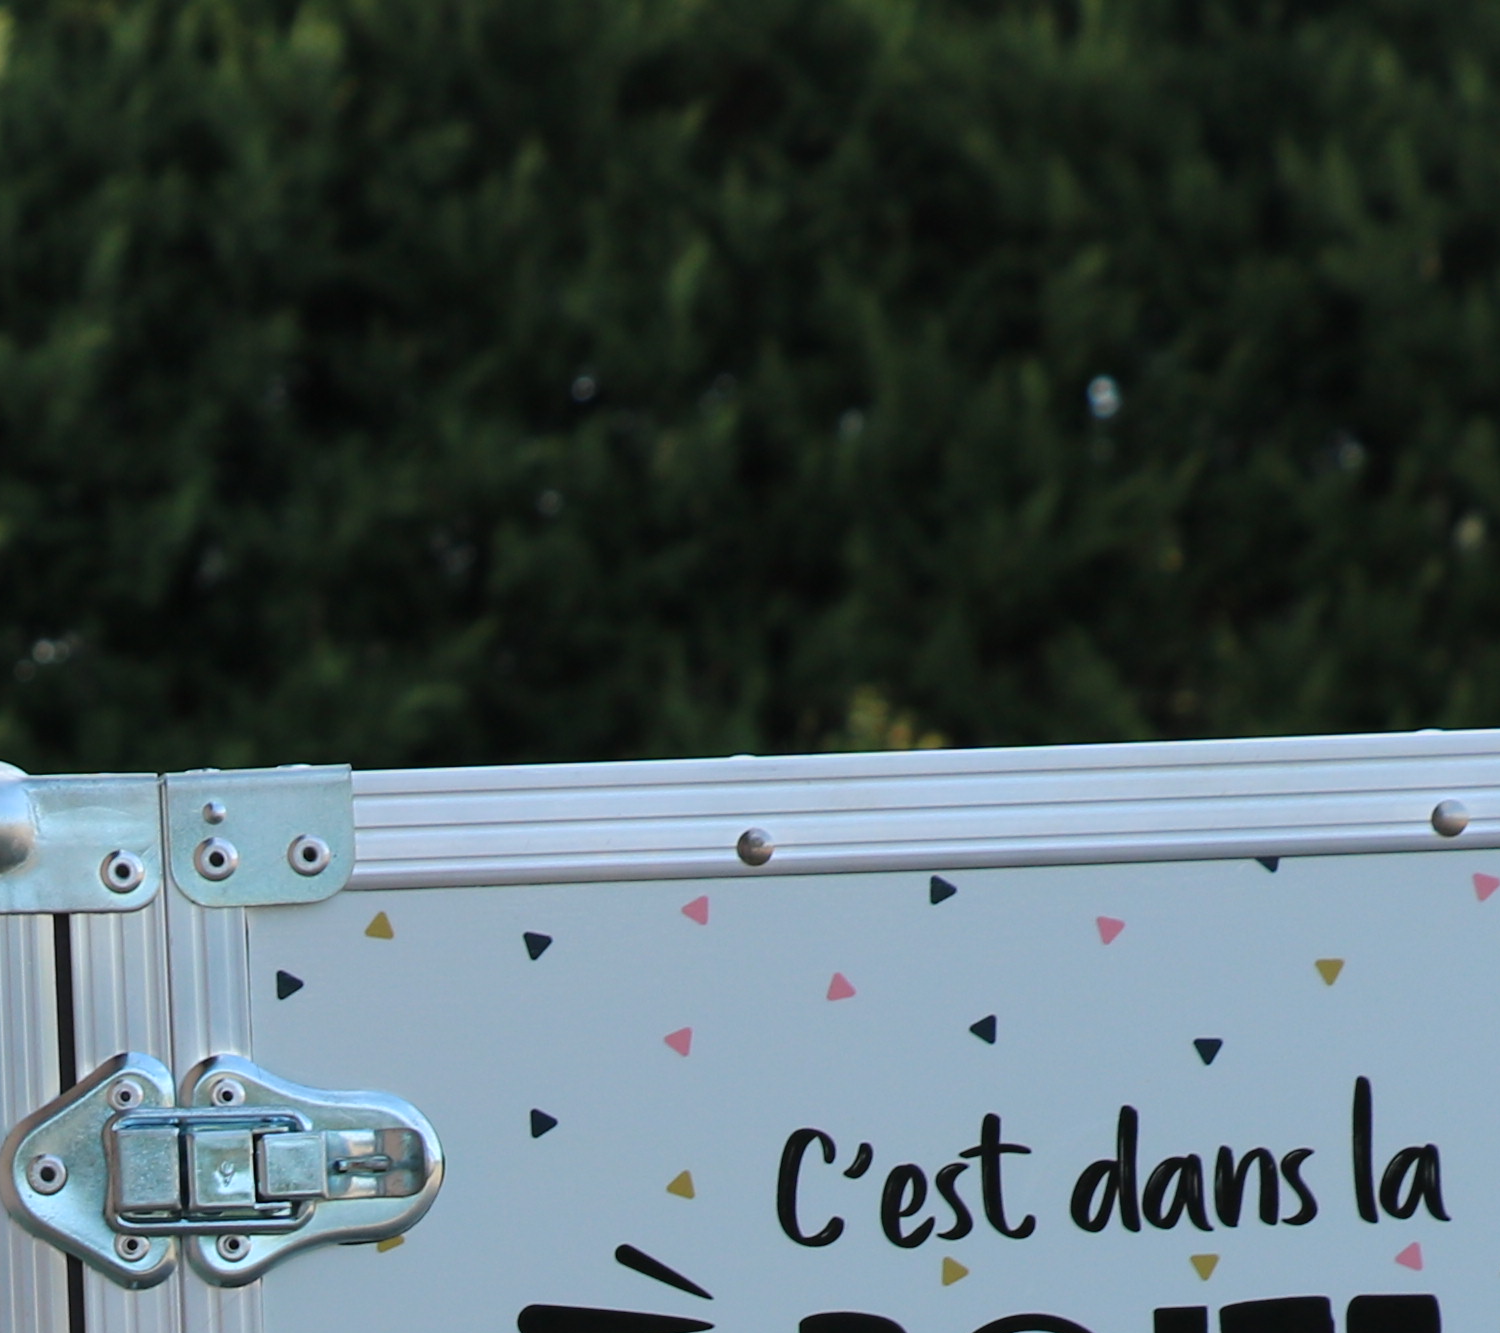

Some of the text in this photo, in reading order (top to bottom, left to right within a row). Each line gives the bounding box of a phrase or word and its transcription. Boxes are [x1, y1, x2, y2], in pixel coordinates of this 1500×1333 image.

[775, 1075, 1452, 1250] C'est dans la
